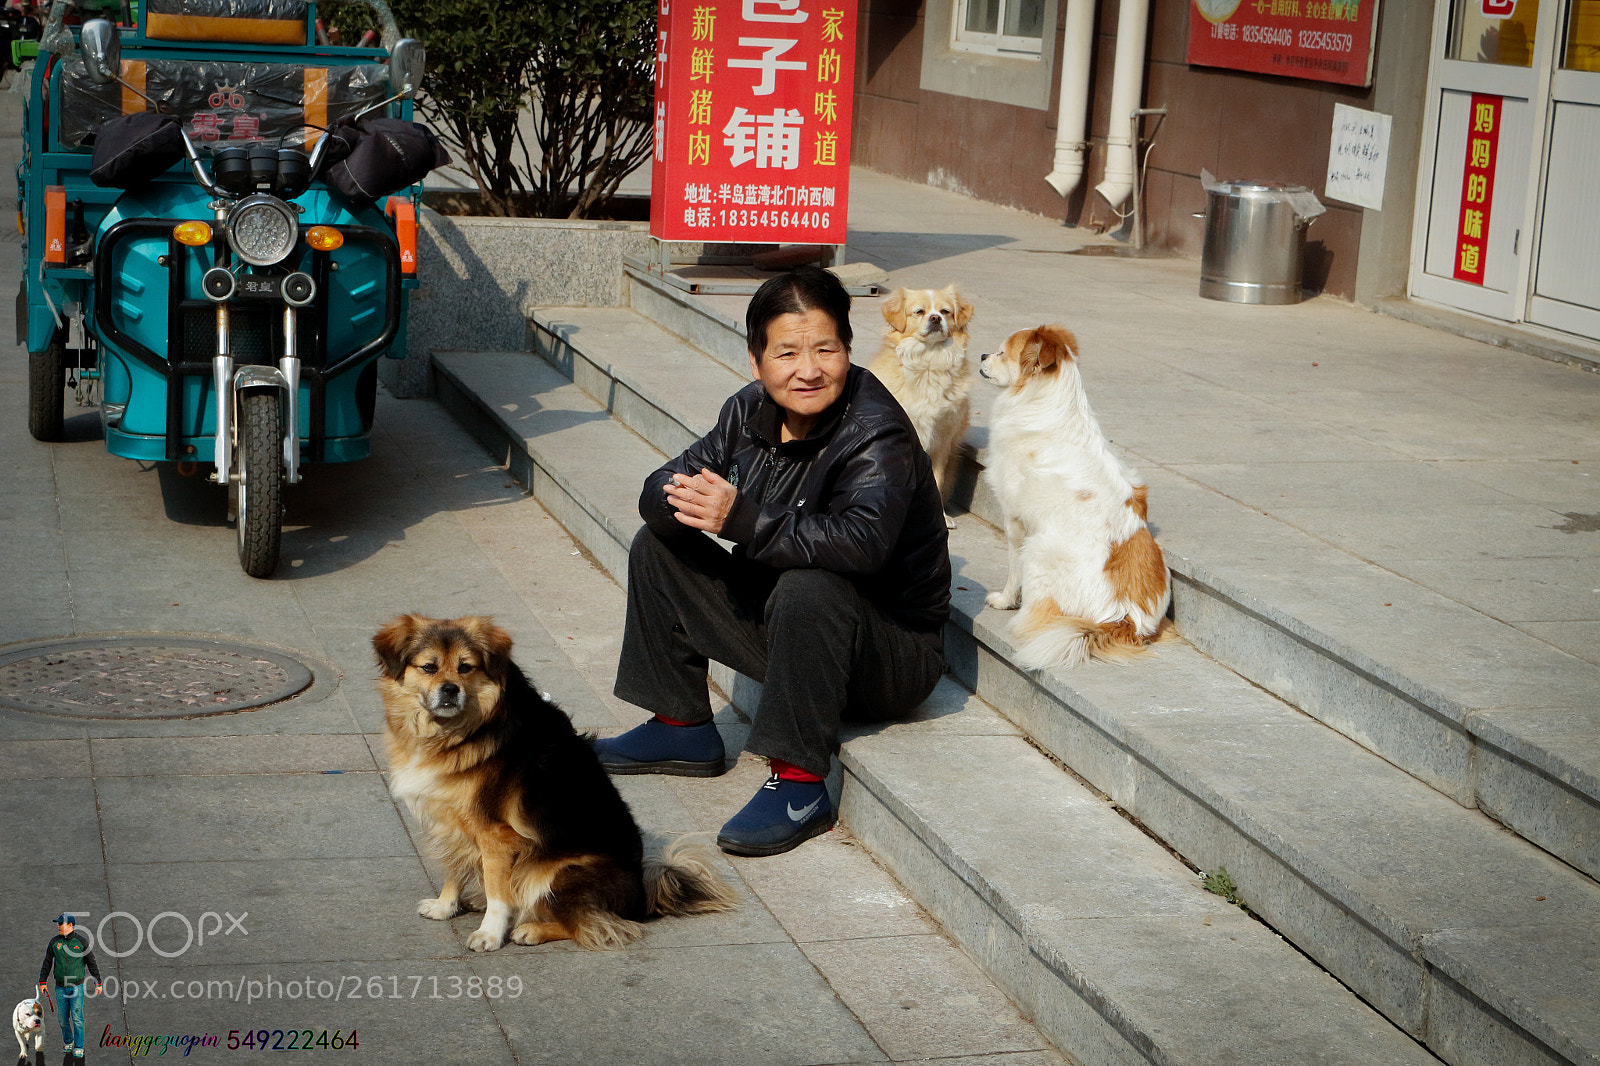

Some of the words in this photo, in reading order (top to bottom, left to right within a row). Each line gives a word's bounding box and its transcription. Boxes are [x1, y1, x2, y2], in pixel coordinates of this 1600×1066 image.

[655, 0, 670, 163] 子铺
[687, 5, 717, 166] 新鲜猪肉
[813, 7, 844, 166] 家的味道
[1242, 25, 1293, 46] 18354564406
[1298, 30, 1352, 52] 13225453579
[187, 112, 265, 142] 君皇
[1460, 102, 1494, 275] 妈妈的味道
